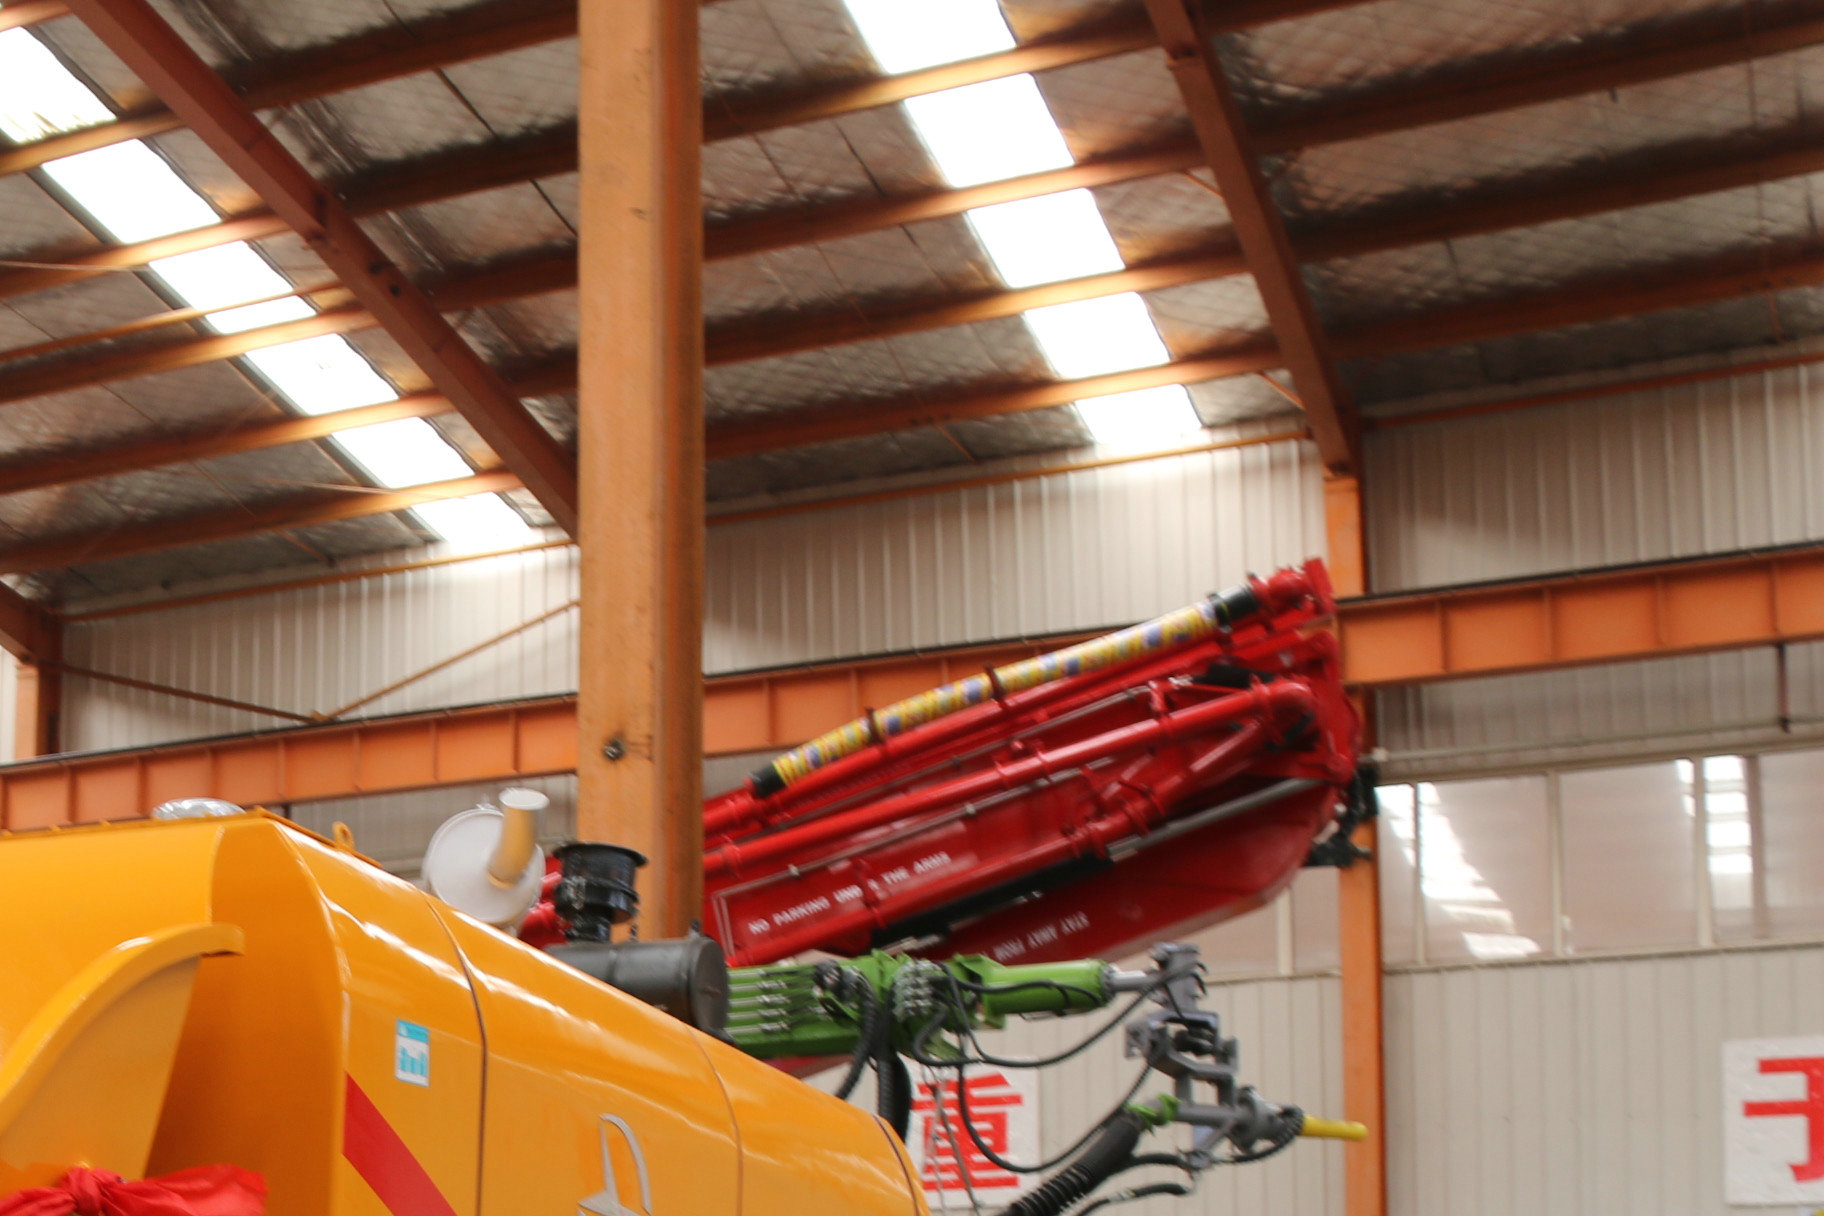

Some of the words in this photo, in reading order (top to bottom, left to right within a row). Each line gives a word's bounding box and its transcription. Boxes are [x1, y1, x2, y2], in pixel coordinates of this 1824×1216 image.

[748, 918, 771, 935] NO
[772, 896, 830, 926] PARKING
[833, 878, 879, 903] UNDR
